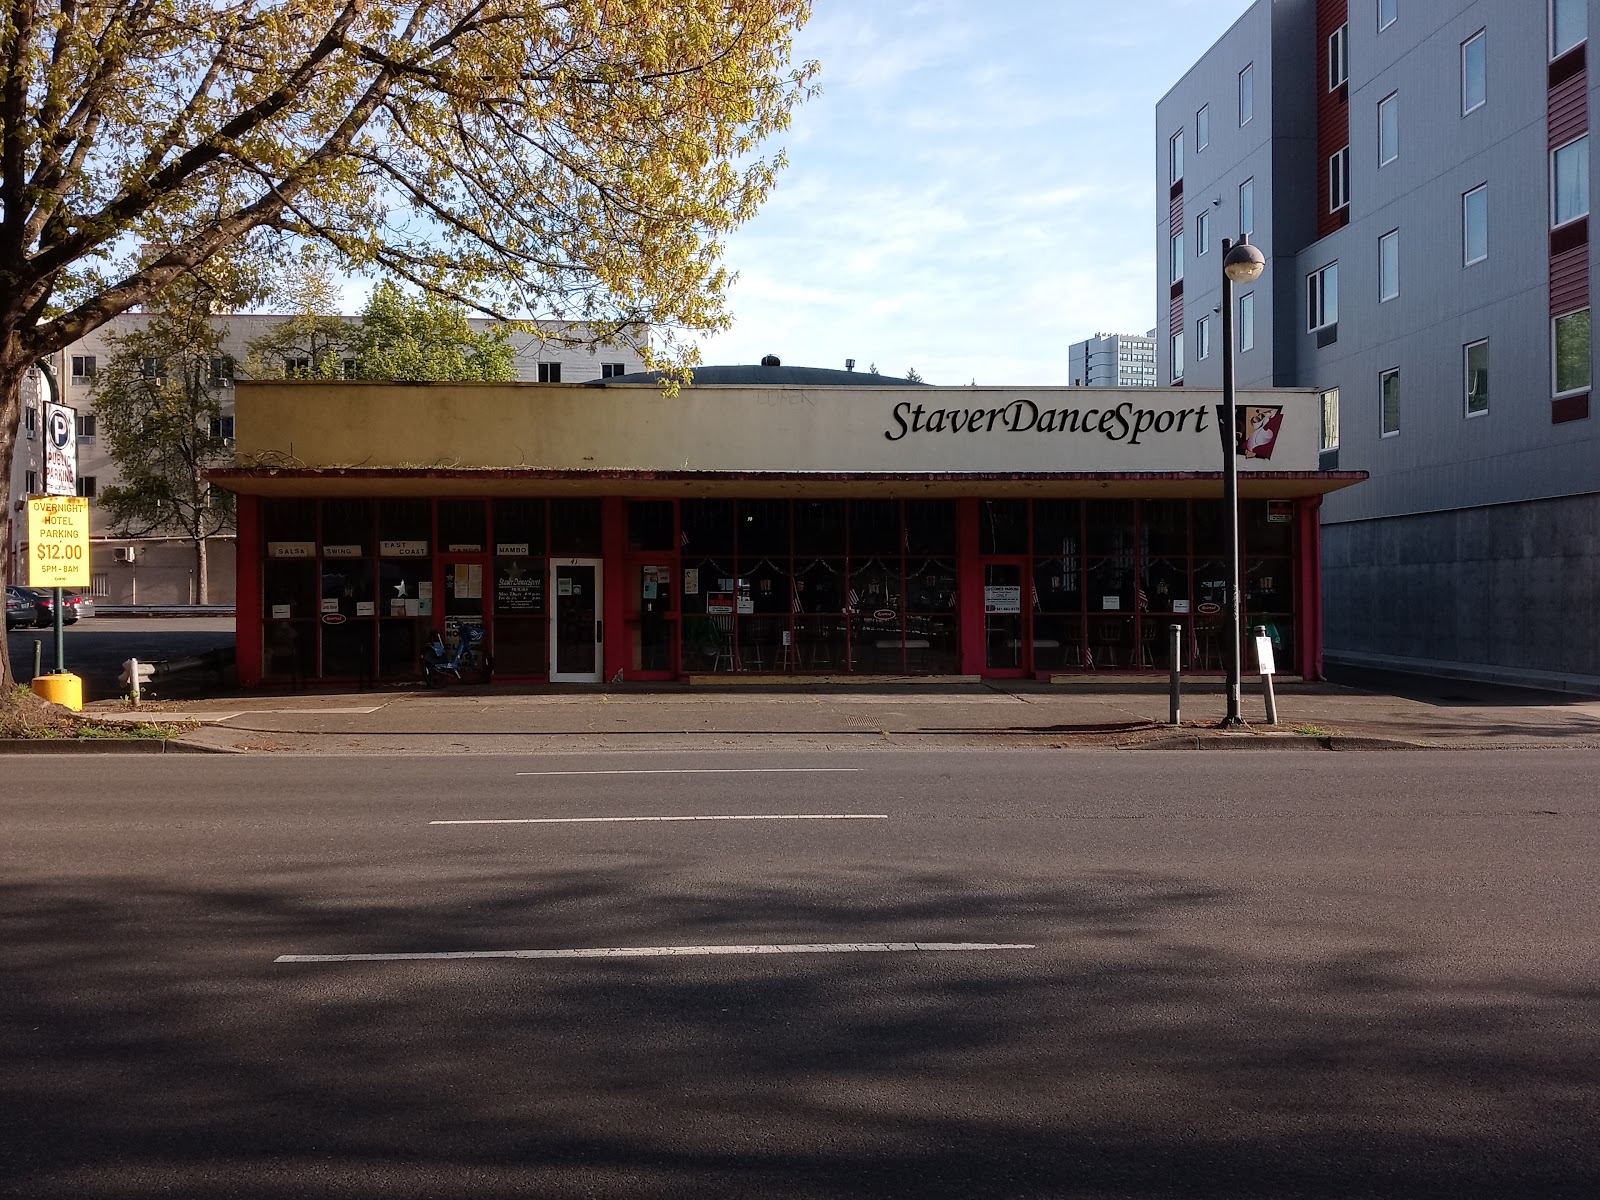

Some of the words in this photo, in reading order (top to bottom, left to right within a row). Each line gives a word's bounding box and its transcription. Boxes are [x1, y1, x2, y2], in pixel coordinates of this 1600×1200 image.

[884, 398, 1212, 444] StaverDanceSport
[47, 452, 72, 468] PUBLIC
[46, 467, 74, 483] PARKING
[33, 502, 83, 513] OVERNIGHT
[44, 516, 74, 526] HOTEL
[39, 529, 79, 539] PARKING
[37, 543, 82, 560] $12.00
[41, 565, 57, 573] 5PM
[63, 565, 79, 573] 8AM
